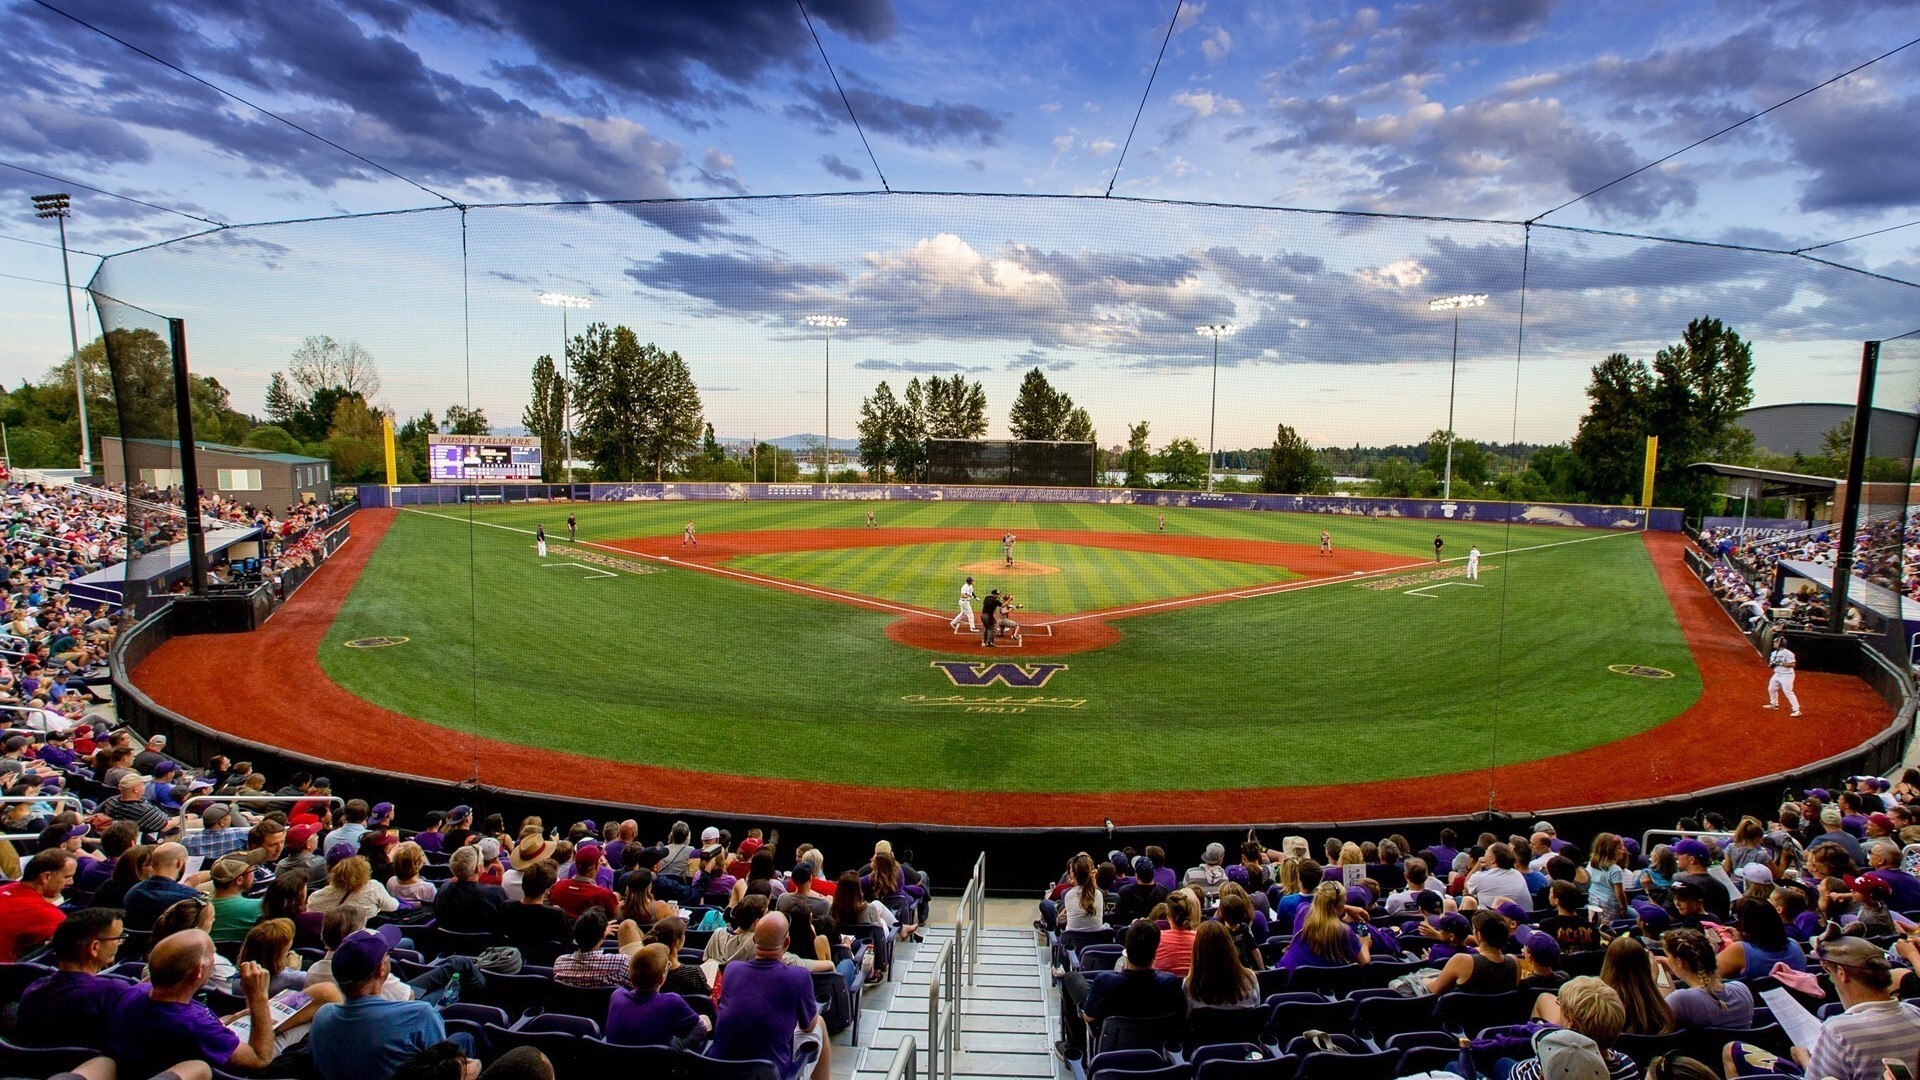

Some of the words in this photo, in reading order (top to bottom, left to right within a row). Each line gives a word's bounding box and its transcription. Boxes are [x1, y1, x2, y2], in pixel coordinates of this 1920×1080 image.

[440, 436, 476, 444] HUSKY
[478, 437, 532, 446] BALLPARK
[945, 488, 1026, 500] WASHINGTON
[1026, 489, 1090, 501] BASEBALL
[930, 661, 1069, 688] W
